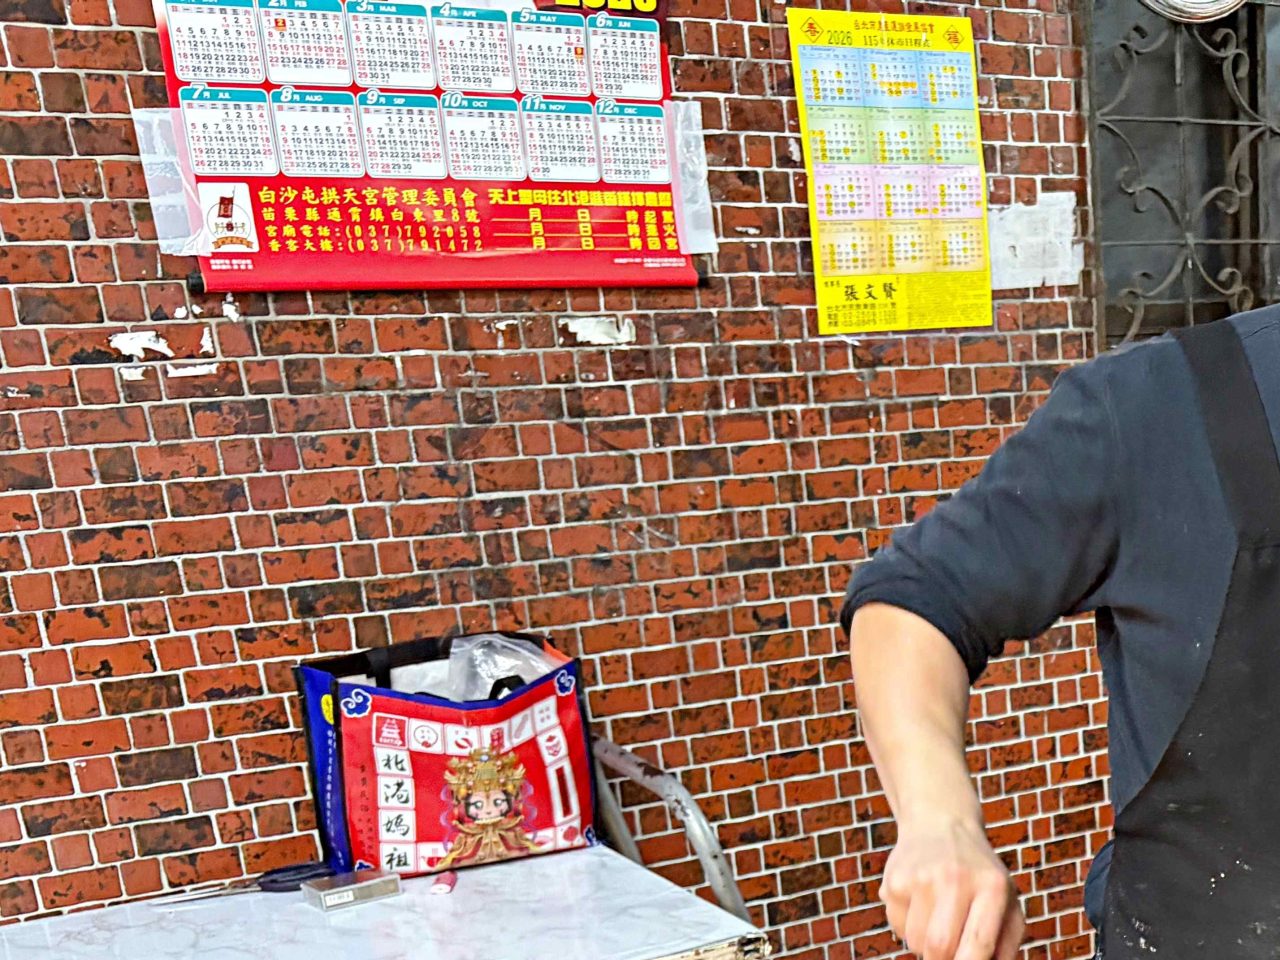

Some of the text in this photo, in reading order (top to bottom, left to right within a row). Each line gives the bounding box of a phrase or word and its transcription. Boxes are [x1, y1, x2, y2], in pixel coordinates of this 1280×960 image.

[827, 30, 853, 45] 2026
[257, 186, 478, 208] 白沙屯拱天宮管理委員會
[529, 208, 541, 221] 月
[577, 208, 591, 222] 日
[530, 222, 543, 235] 月
[579, 223, 592, 236] 日
[532, 236, 546, 250] 月
[581, 237, 594, 250] 日
